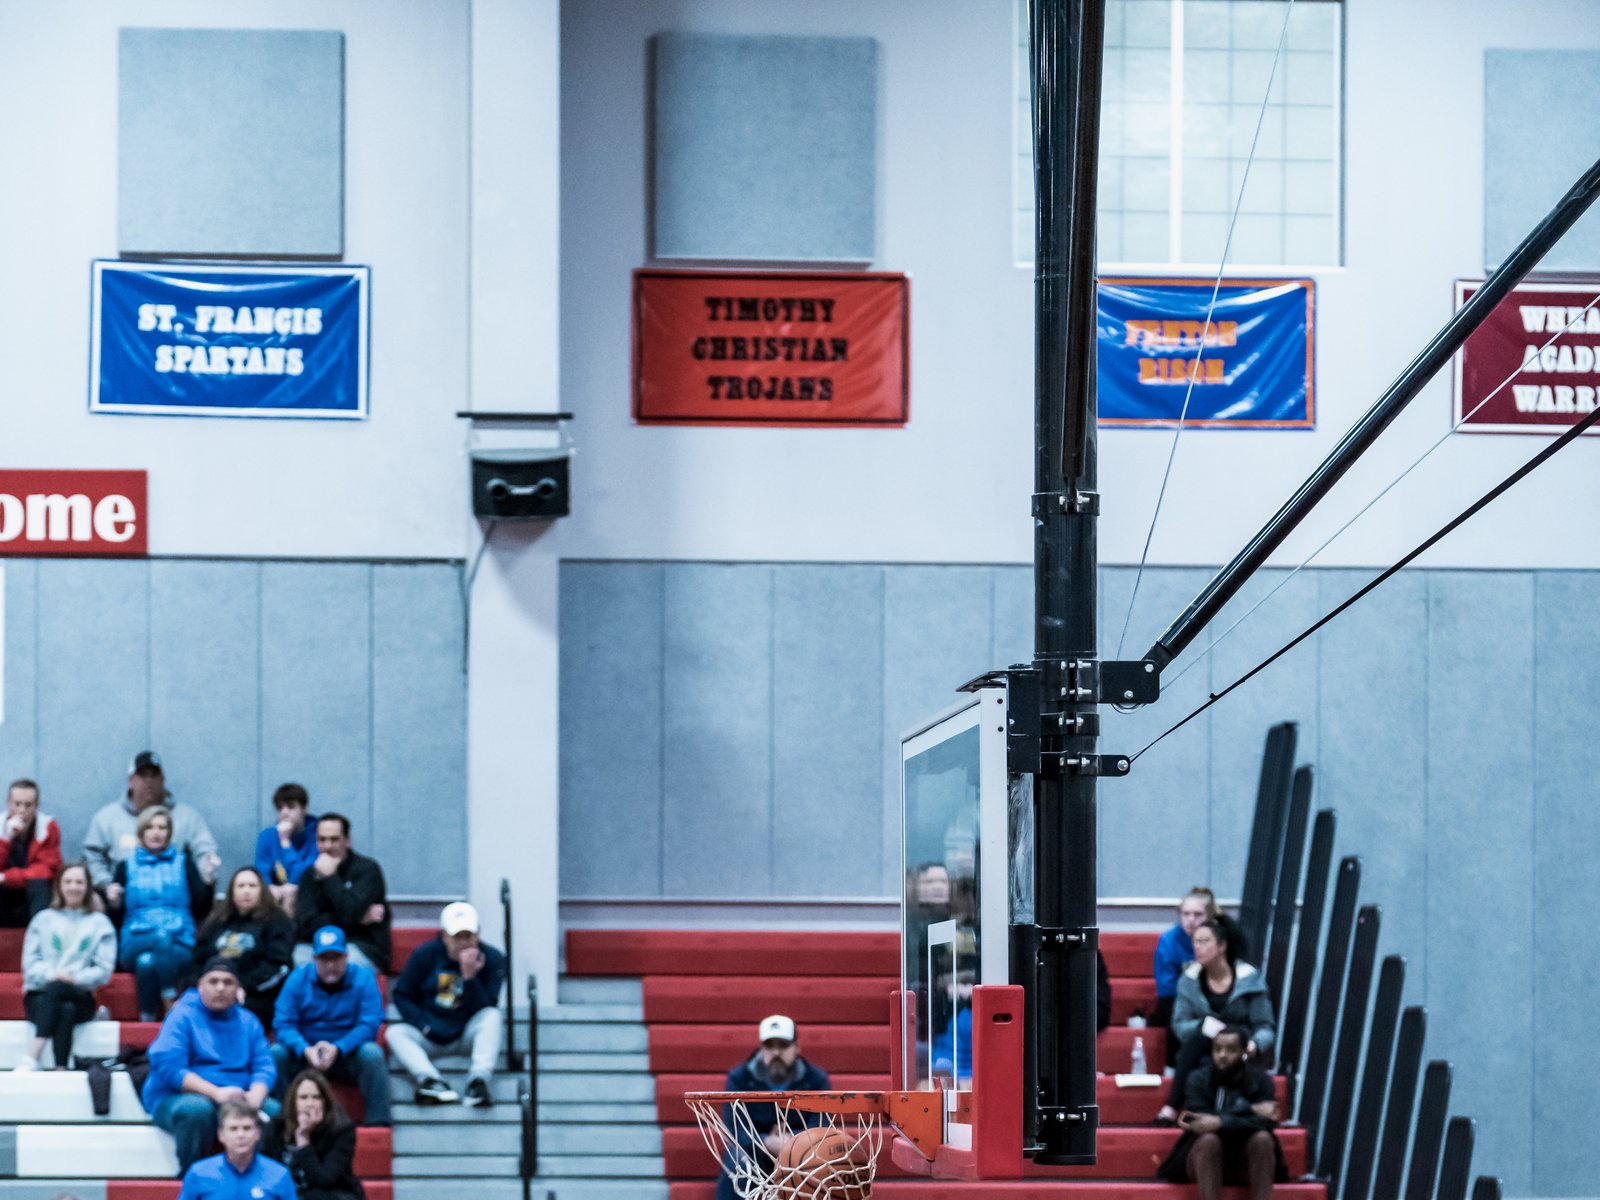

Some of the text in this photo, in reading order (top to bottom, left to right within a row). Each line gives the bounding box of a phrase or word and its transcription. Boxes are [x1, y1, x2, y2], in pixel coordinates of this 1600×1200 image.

[137, 303, 323, 335] ST. FRANCIS
[705, 297, 836, 322] TIMOTHY
[155, 344, 304, 376] SPARTANS
[691, 337, 848, 362] CHRISTIAN
[1138, 358, 1225, 385] BISON
[707, 375, 834, 401] TROJANS
[1512, 384, 1600, 414] WARR
